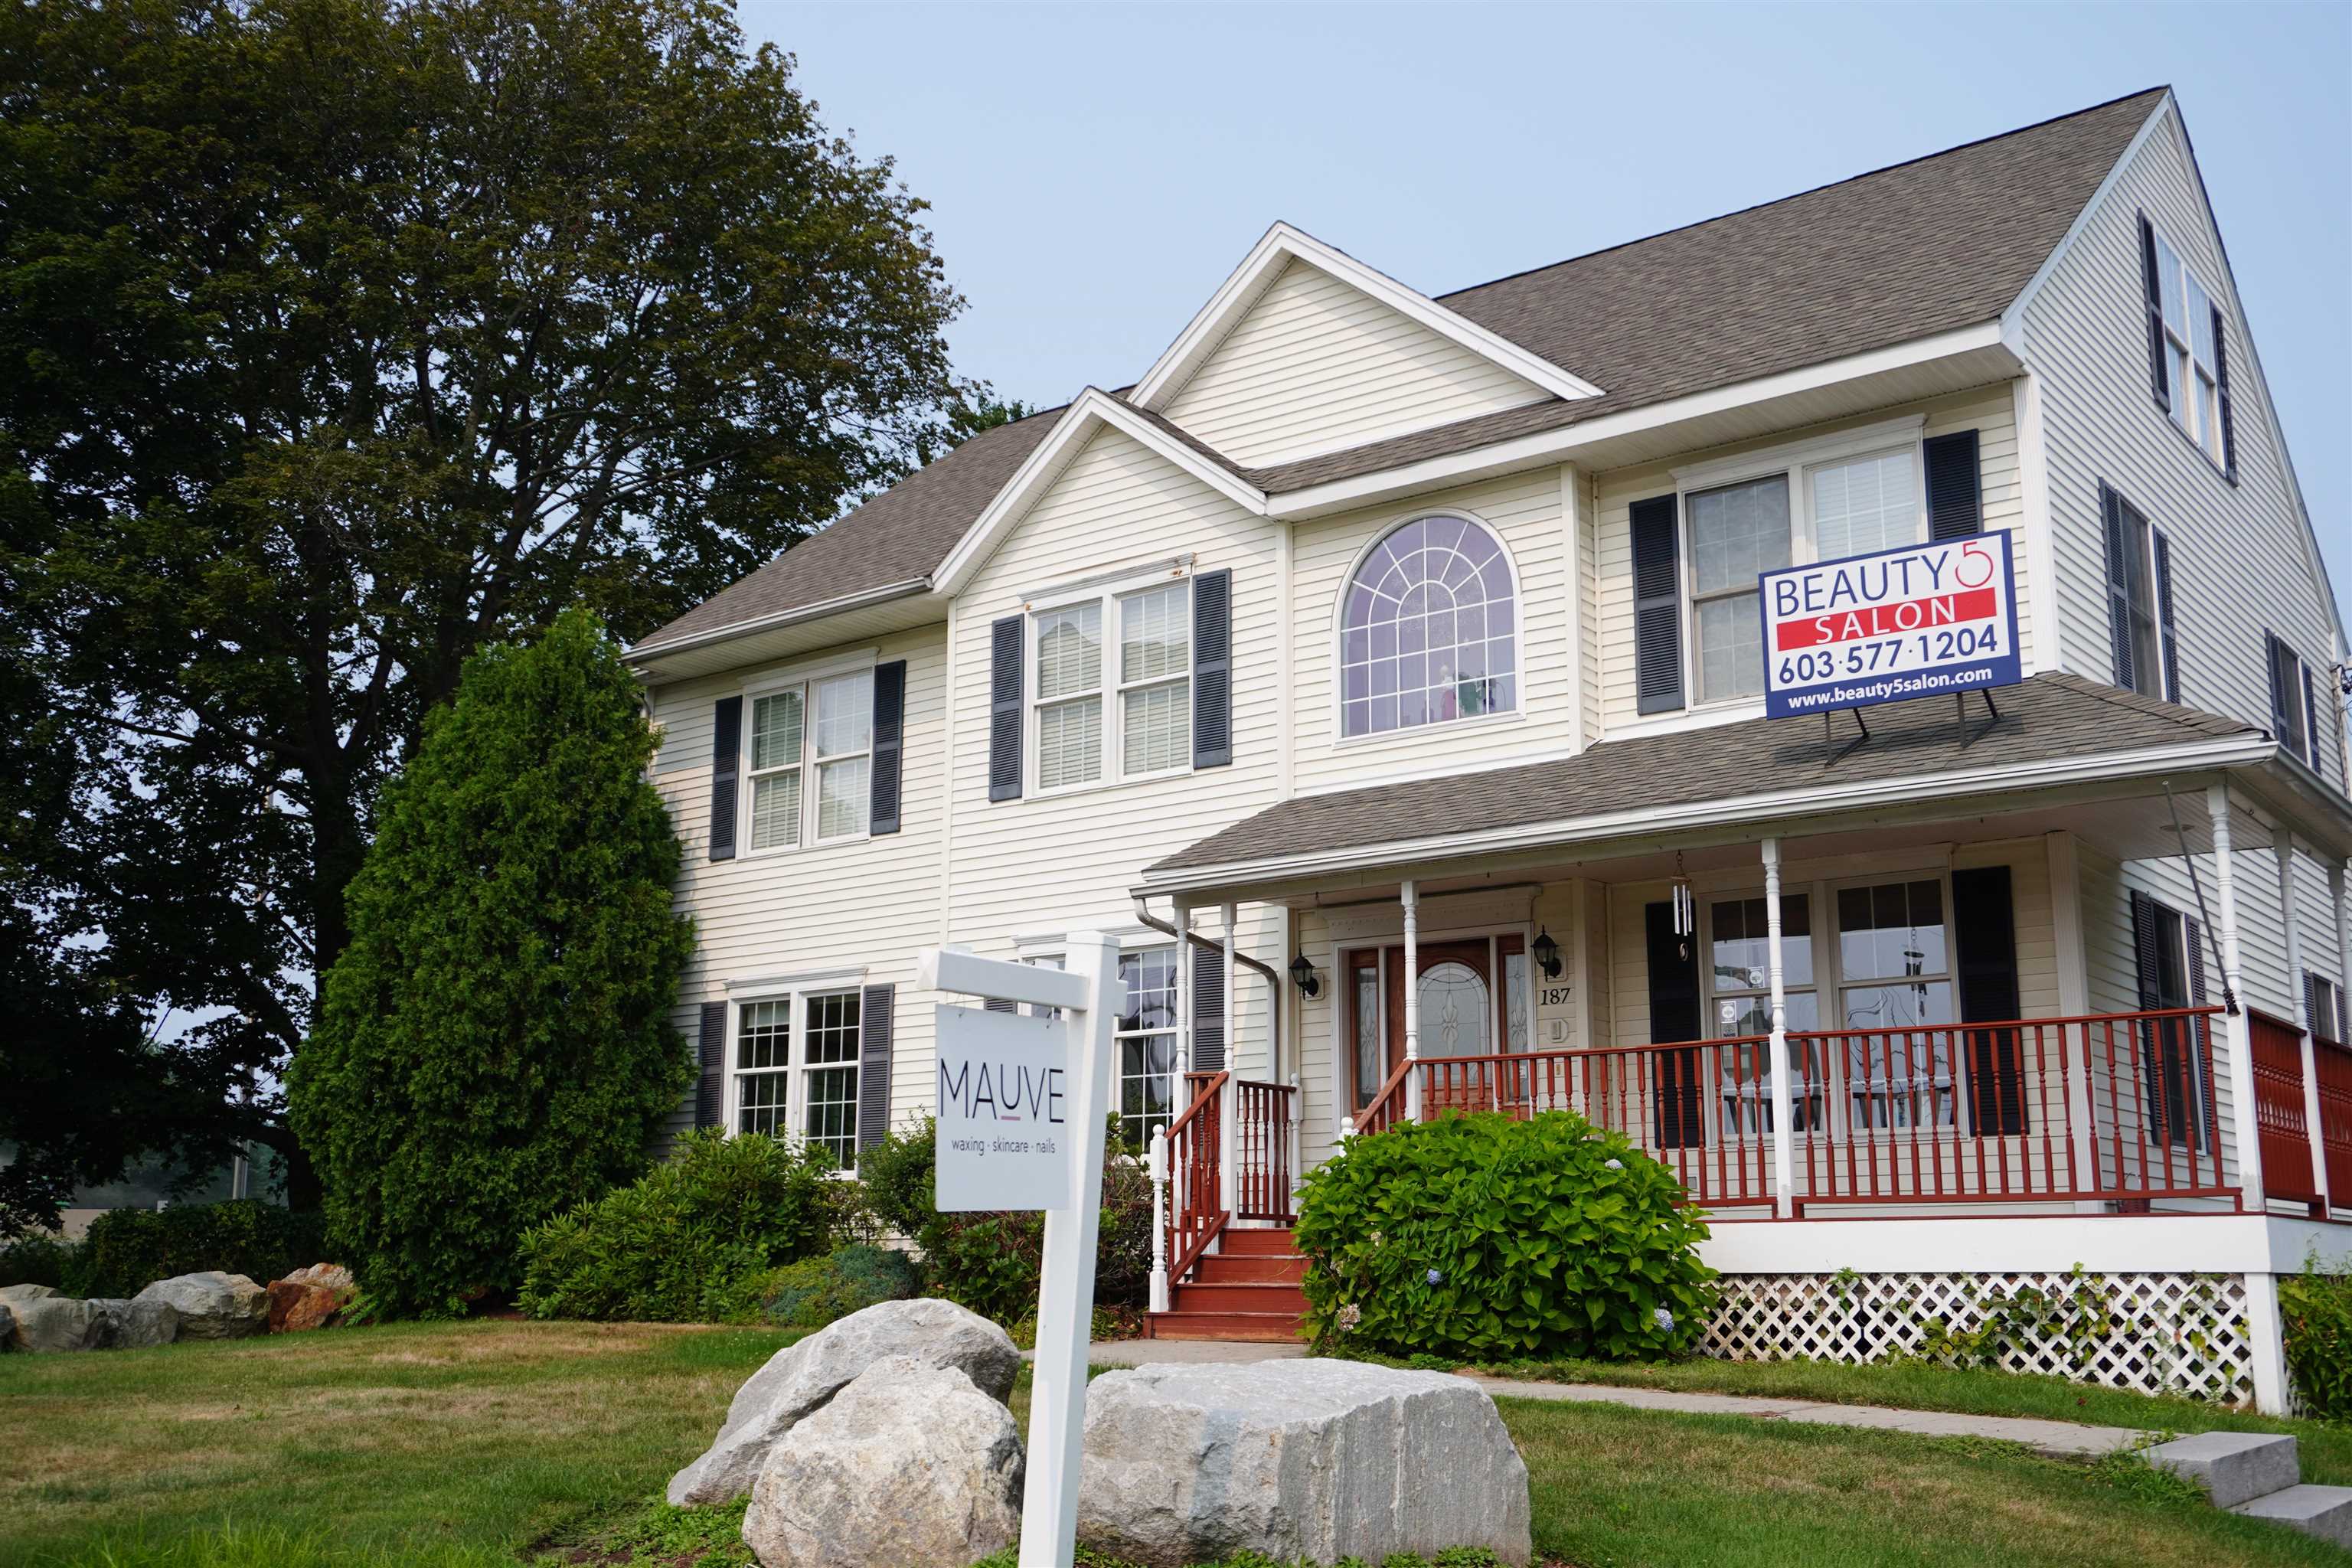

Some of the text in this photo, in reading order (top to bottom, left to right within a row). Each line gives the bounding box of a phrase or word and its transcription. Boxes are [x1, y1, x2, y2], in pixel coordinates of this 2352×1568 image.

[1776, 550, 1949, 617] BEAUTY
[1815, 595, 1955, 644] SALON
[1788, 666, 1992, 709] www.beauty5salon.com
[1540, 987, 1571, 1005] 187
[940, 1057, 1064, 1123] MAUVE
[952, 1136, 1055, 1156] waxing skincare nails
